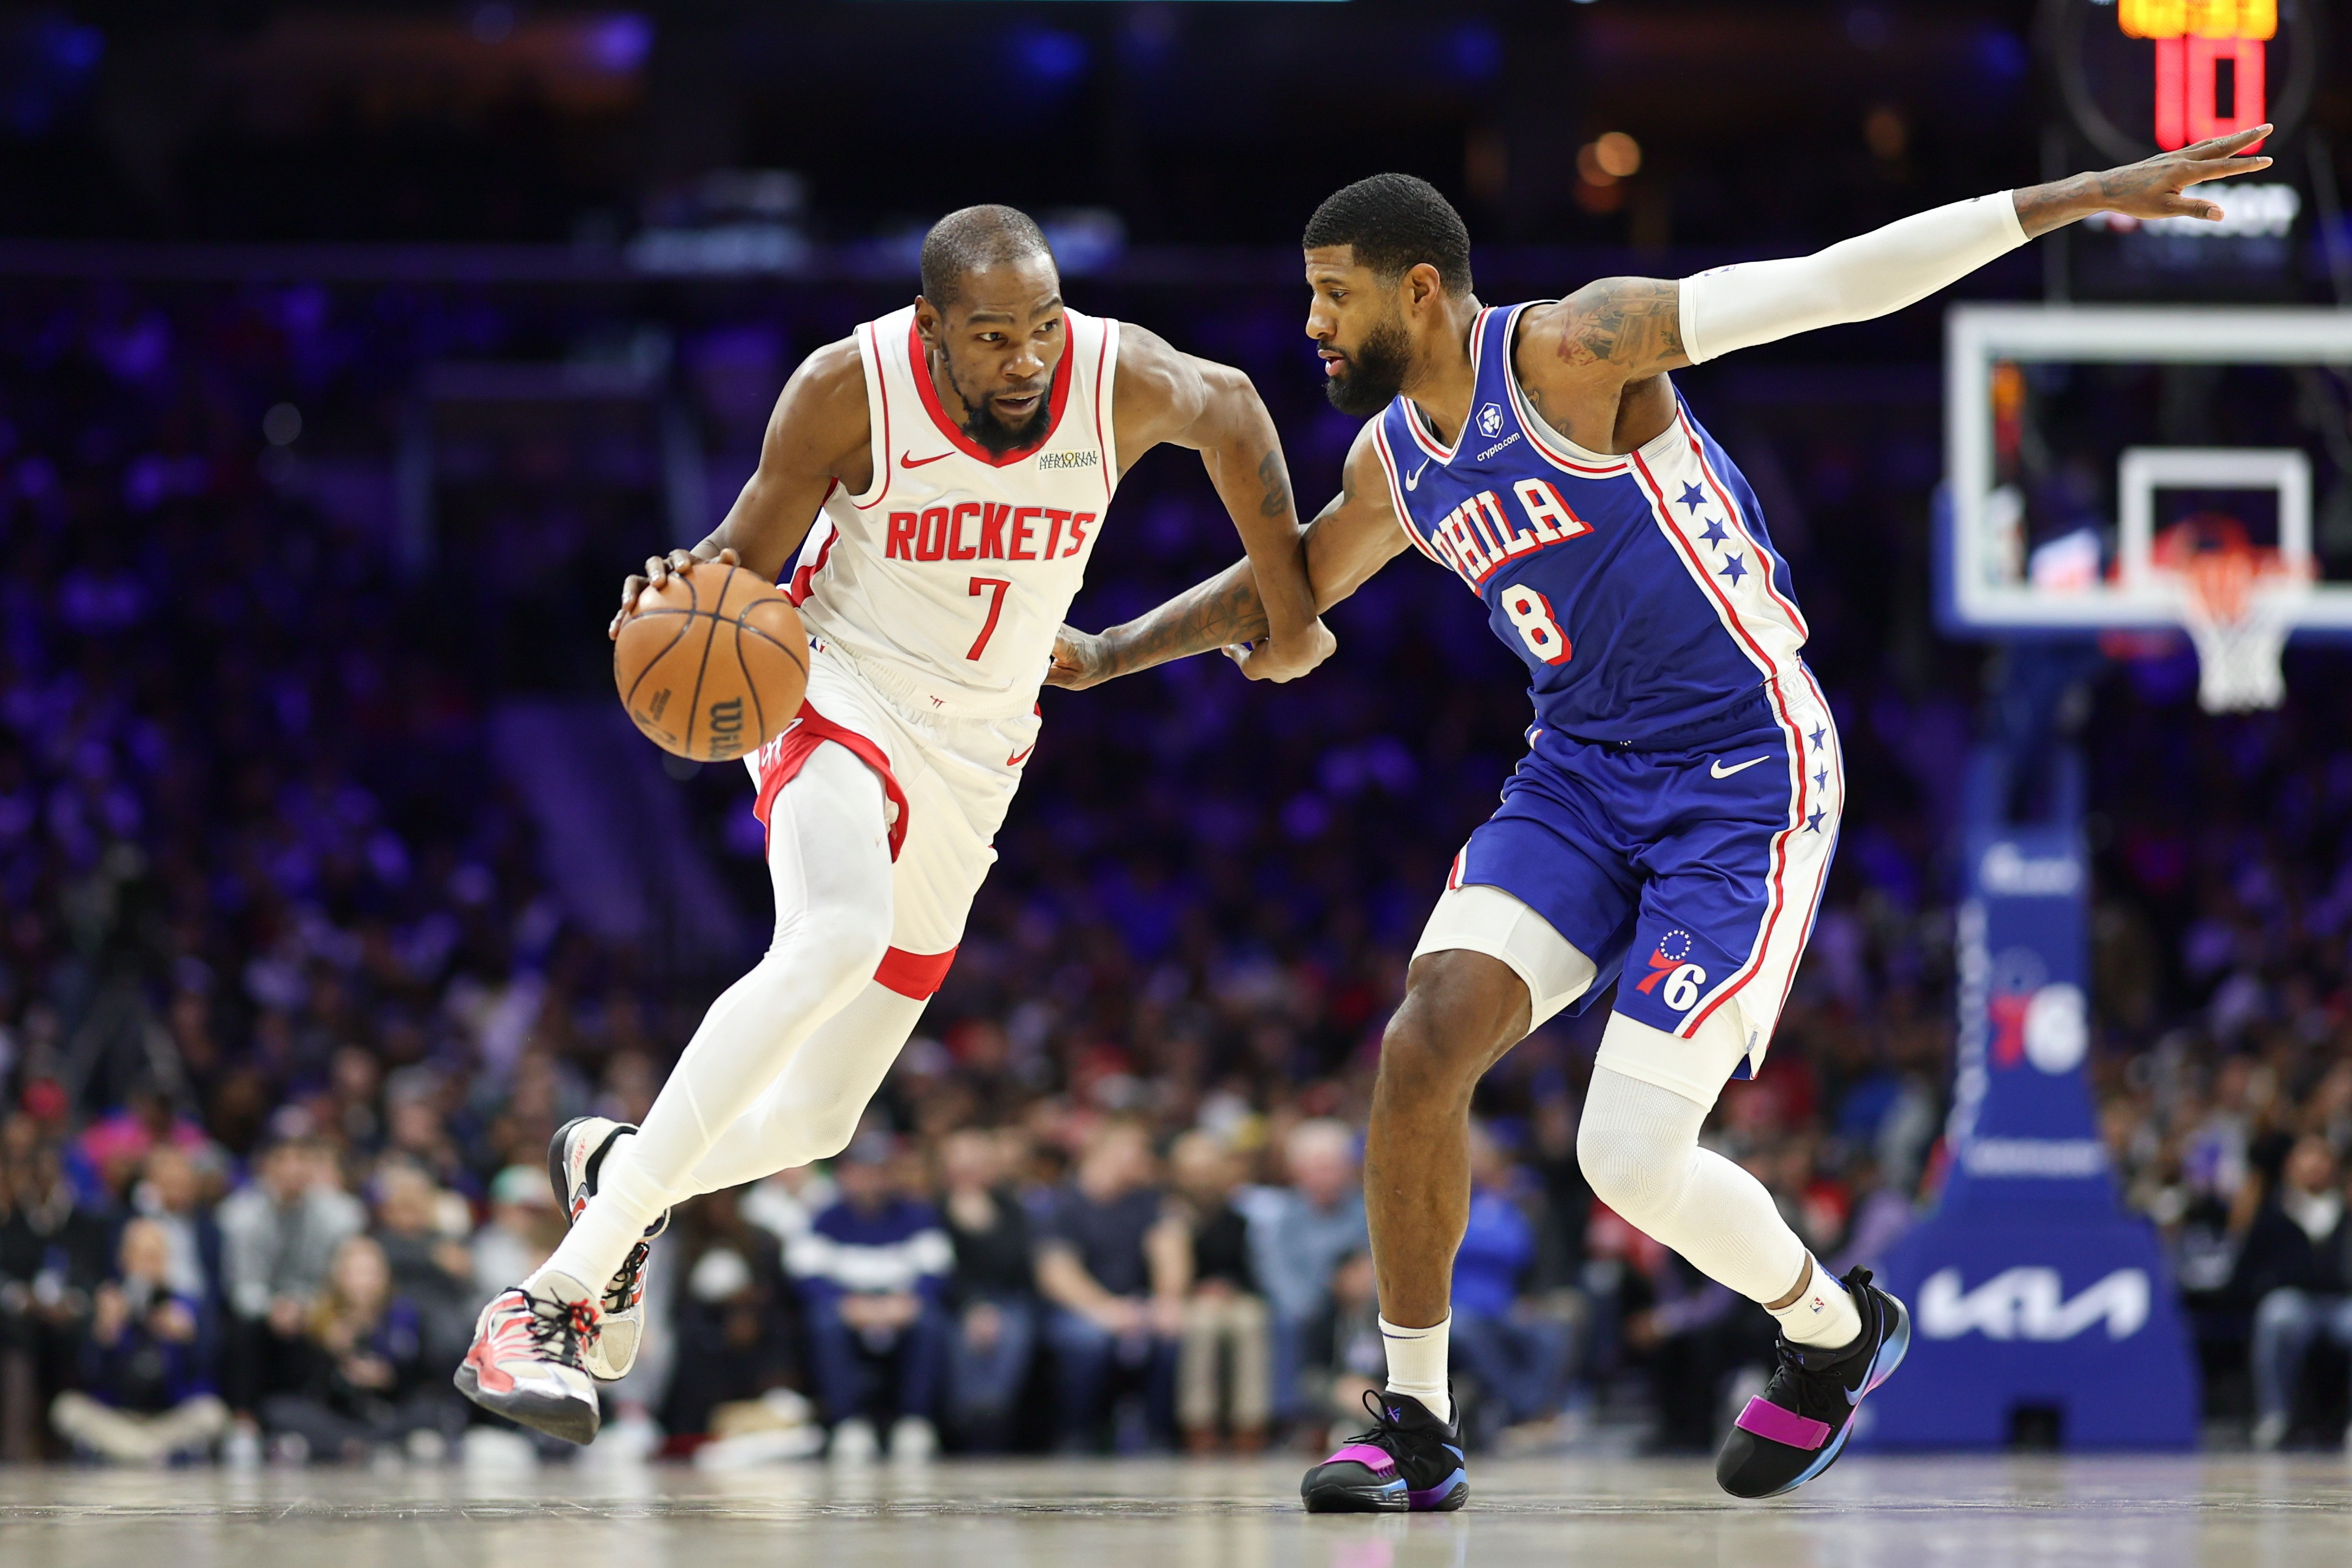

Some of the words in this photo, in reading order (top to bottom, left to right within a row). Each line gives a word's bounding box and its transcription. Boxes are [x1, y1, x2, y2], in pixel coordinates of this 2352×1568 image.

[2155, 38, 2265, 155] 10
[1039, 450, 1098, 463] MEMORIAL
[1039, 456, 1097, 470] HERMANN
[1477, 432, 1521, 462] crypto.com
[885, 500, 1097, 562] ROCKETS
[1431, 477, 1595, 599] PHILA
[966, 576, 1012, 662] 7
[1501, 583, 1572, 666] 8
[1635, 948, 1707, 1012] 76
